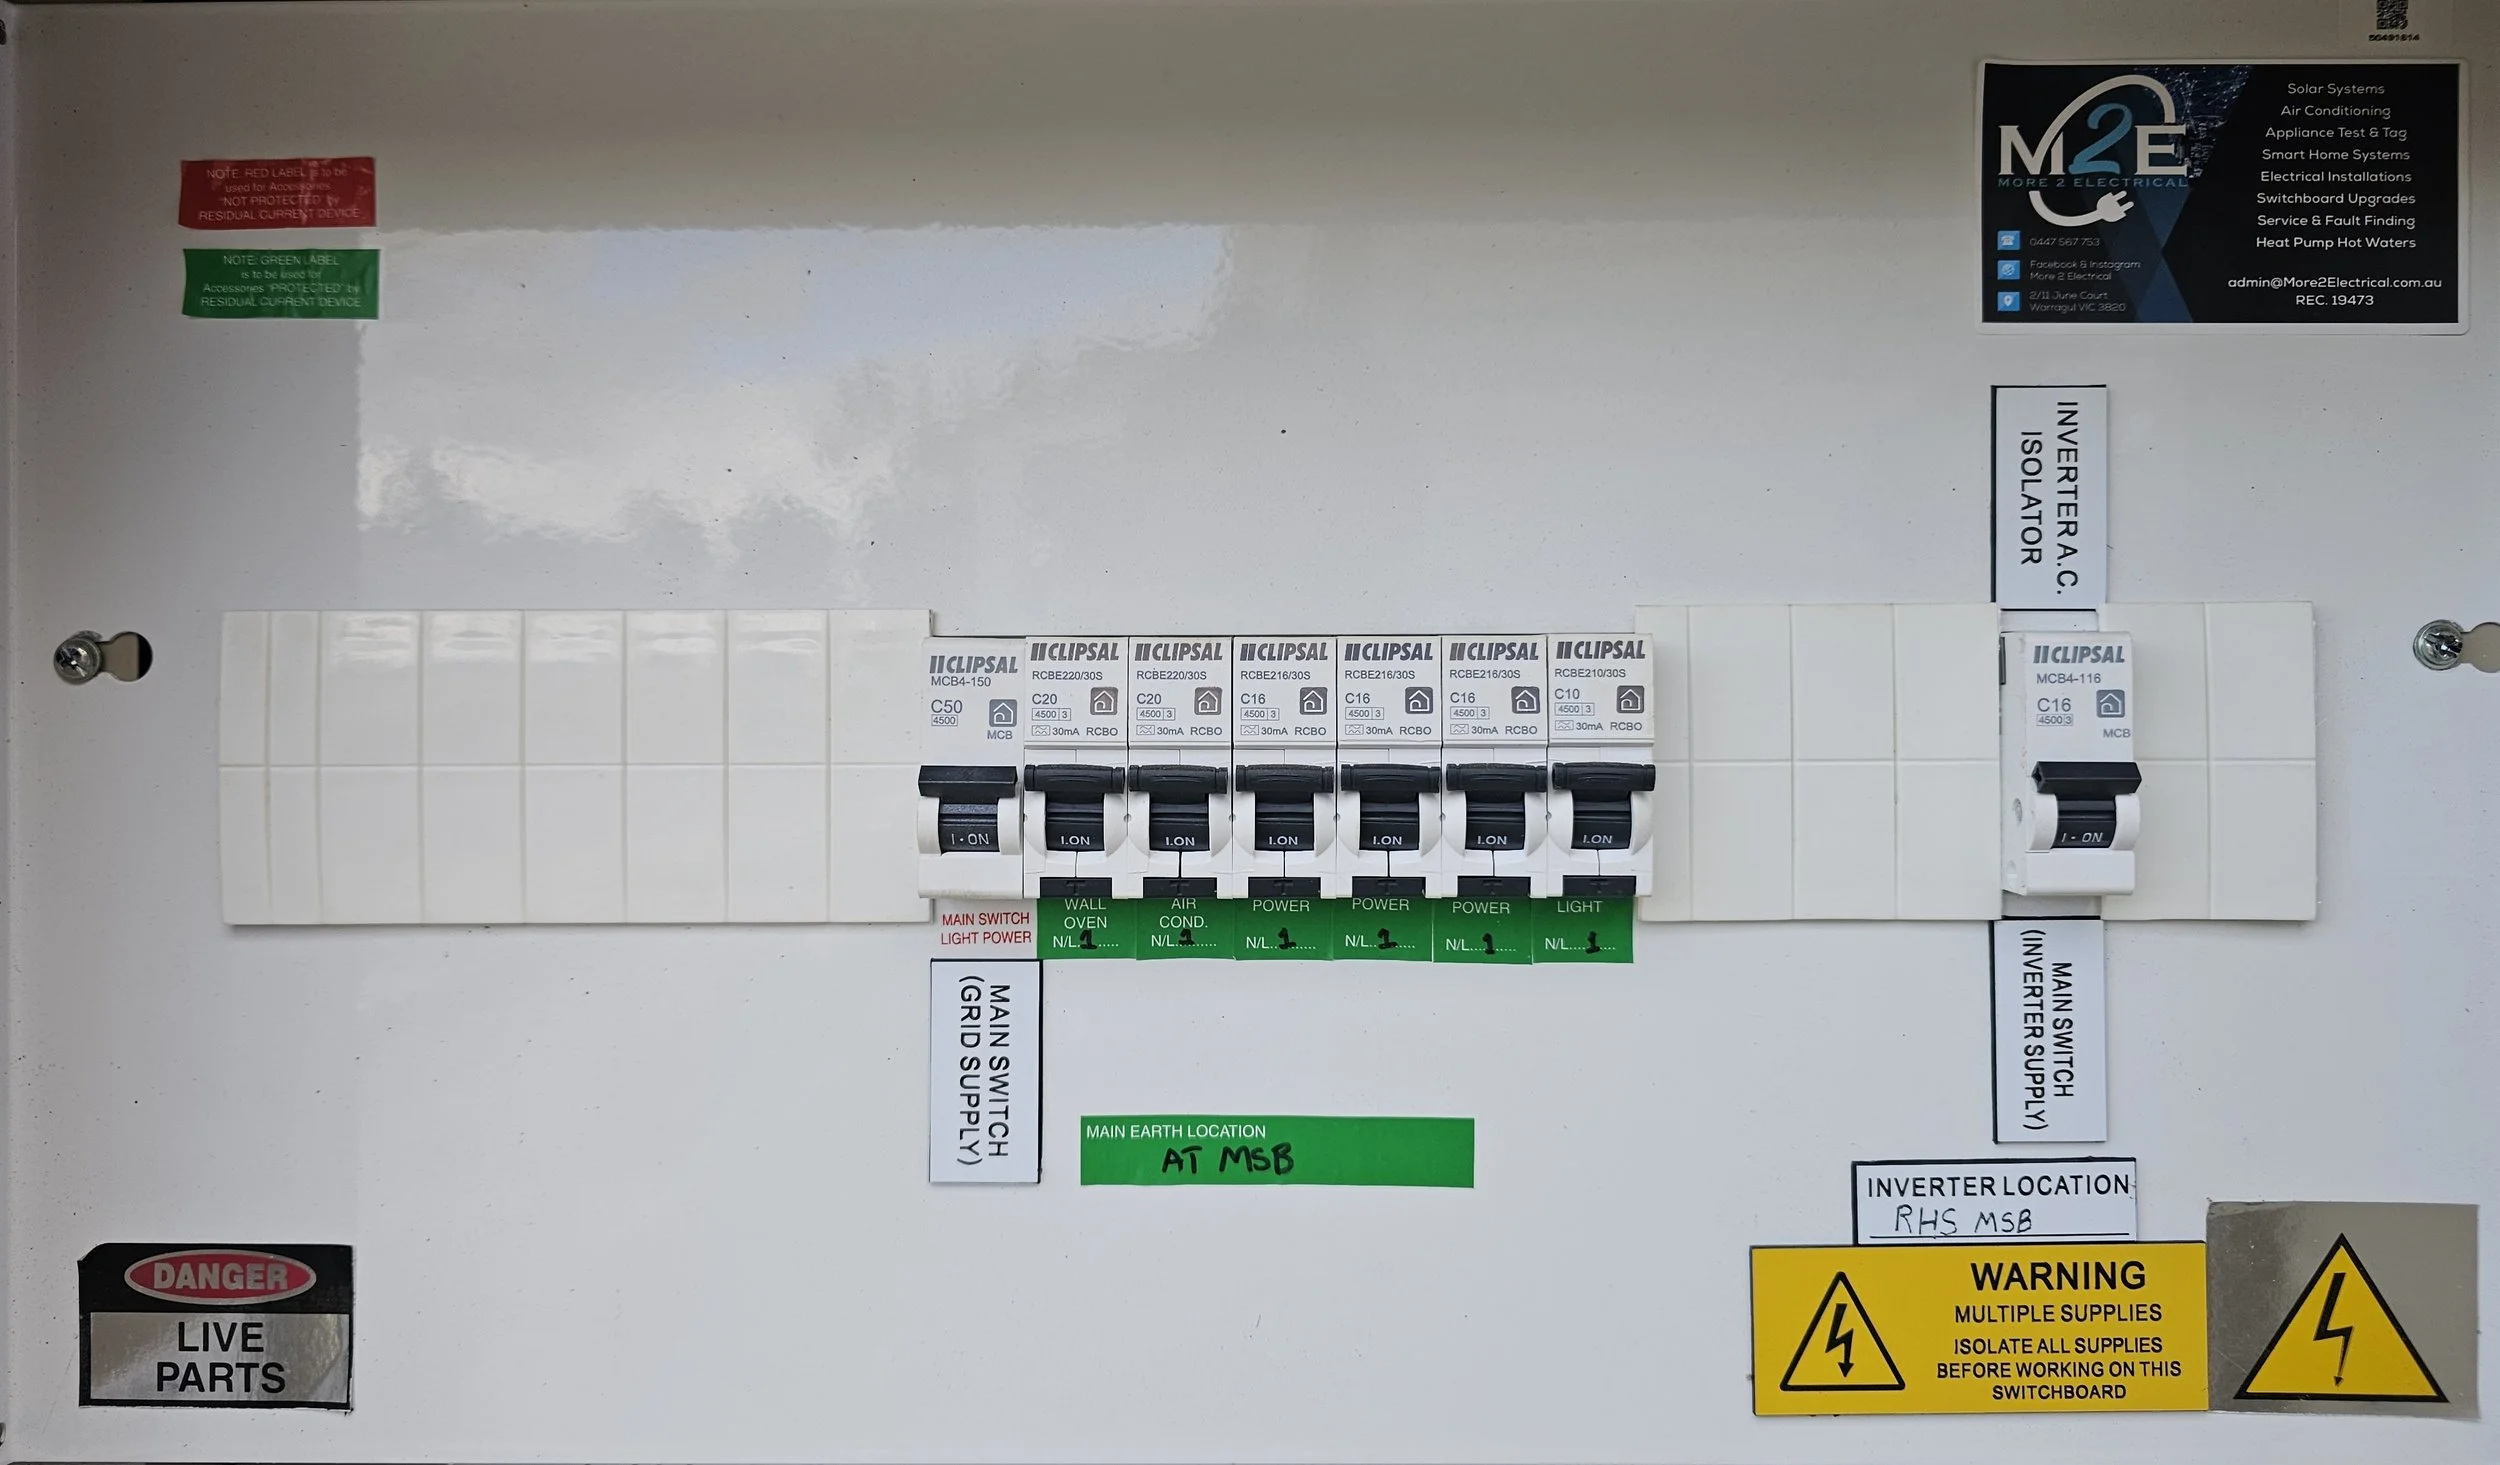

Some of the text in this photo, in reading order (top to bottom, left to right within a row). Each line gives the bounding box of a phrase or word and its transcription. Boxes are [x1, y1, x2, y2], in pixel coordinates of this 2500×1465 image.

[2288, 83, 2385, 97] Solar Systems
[2280, 105, 2391, 120] Air Conditioning
[1998, 103, 2187, 175] M2E
[2265, 127, 2408, 142] Appliance Test & Tag
[2262, 149, 2411, 162] Smart Home Systems
[245, 168, 269, 178] RED
[272, 167, 306, 178] LABEL
[2260, 171, 2412, 182] Electrical Installations
[1998, 178, 2188, 187] MORE 2 ELECTRICAL
[2256, 192, 2416, 207] Switchboard Upgrades
[198, 208, 359, 221] RESIDUAL CURRENT DEVICE
[2257, 215, 2416, 229] Service & Fault Finding
[2029, 238, 2056, 247] 0447
[2256, 237, 2416, 250] Heat Pump Hot Waters
[260, 255, 301, 265] GREEN
[304, 255, 340, 265] LABEL
[2030, 260, 2077, 269] Facebook
[2089, 260, 2141, 271] Instagram
[2030, 272, 2112, 280] More 2 Electrical
[202, 283, 264, 293] Accessories
[347, 283, 360, 295] by
[2228, 277, 2442, 289] admin@More2Electrical.com.au
[2029, 291, 2108, 300] 2/11 June Court
[2296, 295, 2374, 305] REC. 19473
[201, 297, 363, 308] RESIDUAL CURRENT DEVICE
[2029, 303, 2076, 314] Warragul
[2078, 303, 2096, 312] VIC
[2020, 432, 2043, 565] ISOLATOR
[2057, 402, 2078, 594] INVERTER A.C.
[1049, 642, 1119, 661] CLIPSAL
[1153, 642, 1223, 661] CLIPSAL
[1257, 642, 1328, 661] CLIPSAL
[1364, 642, 1433, 661] CLIPSAL
[1469, 641, 1539, 661] CLIPSAL
[1575, 640, 1645, 660] CLIPSAL
[2050, 645, 2125, 664] CLIPSAL
[946, 656, 1018, 674] CLIPSAL
[1032, 671, 1103, 681] RCBE220/30S
[1136, 671, 1207, 681] RCBE220/30S
[1241, 671, 1311, 680] RCBE216/30S
[1345, 670, 1415, 680] RCBE216/30S
[1450, 669, 1520, 679] RCBE216/30S
[1555, 668, 1626, 678] RCBE210/30S
[2037, 673, 2101, 684] MCB4-116
[931, 676, 991, 687] MCB4-150
[1032, 693, 1058, 705] C20
[1136, 693, 1162, 705] C20
[1241, 693, 1266, 705] C16
[1345, 692, 1370, 704] C16
[1450, 692, 1475, 704] C16
[1555, 688, 1580, 700] C10
[931, 700, 963, 714] C50
[2037, 698, 2071, 712] C16
[933, 715, 957, 725] 4500
[1035, 710, 1069, 719] 4500 3
[2038, 715, 2063, 725] 4500
[1052, 726, 1118, 736] 30mA RCBO
[1261, 726, 1327, 736] 30mA RCBO
[1576, 721, 1642, 732] 30mA RCBO
[2103, 728, 2131, 738] MCB
[987, 730, 1013, 740] MCB
[1064, 898, 1107, 910] WALL
[1171, 897, 1196, 909] AIR
[1253, 900, 1310, 912] POWER
[1352, 898, 1409, 911] POWER
[1452, 902, 1510, 914] POWER
[1557, 900, 1603, 913] LIGHT
[942, 912, 1030, 926] MAIN SWITCH
[1064, 916, 1107, 929] OVEN
[1160, 916, 1208, 929] COND.
[941, 931, 1032, 945] LIGHT POWER
[2020, 930, 2048, 1130] (INVERTER SUPPLY)
[2052, 963, 2074, 1097] MAIN SWITCH
[957, 975, 985, 1166] (GRID SUPPLY)
[988, 984, 1010, 1158] MAIN SWITCH
[1087, 1124, 1266, 1139] MAIN EARTH LOCATION
[1162, 1143, 1294, 1175] AT MSB
[1868, 1174, 2130, 1199] INVERTER LOCATION
[1894, 1205, 2033, 1236] RHS MSB
[153, 1262, 289, 1290] DANGER
[1970, 1261, 2146, 1292] WARNING
[1954, 1304, 2162, 1324] MULTIPLE SUPPLIES
[178, 1322, 264, 1352] LIVE
[1954, 1336, 2163, 1355] ISOLATE ALL SUPPLIES
[1937, 1361, 2182, 1379] BEFORE WORKING ON THIS
[157, 1361, 286, 1393] PARTS
[1992, 1384, 2127, 1401] SWITCHBOARD
